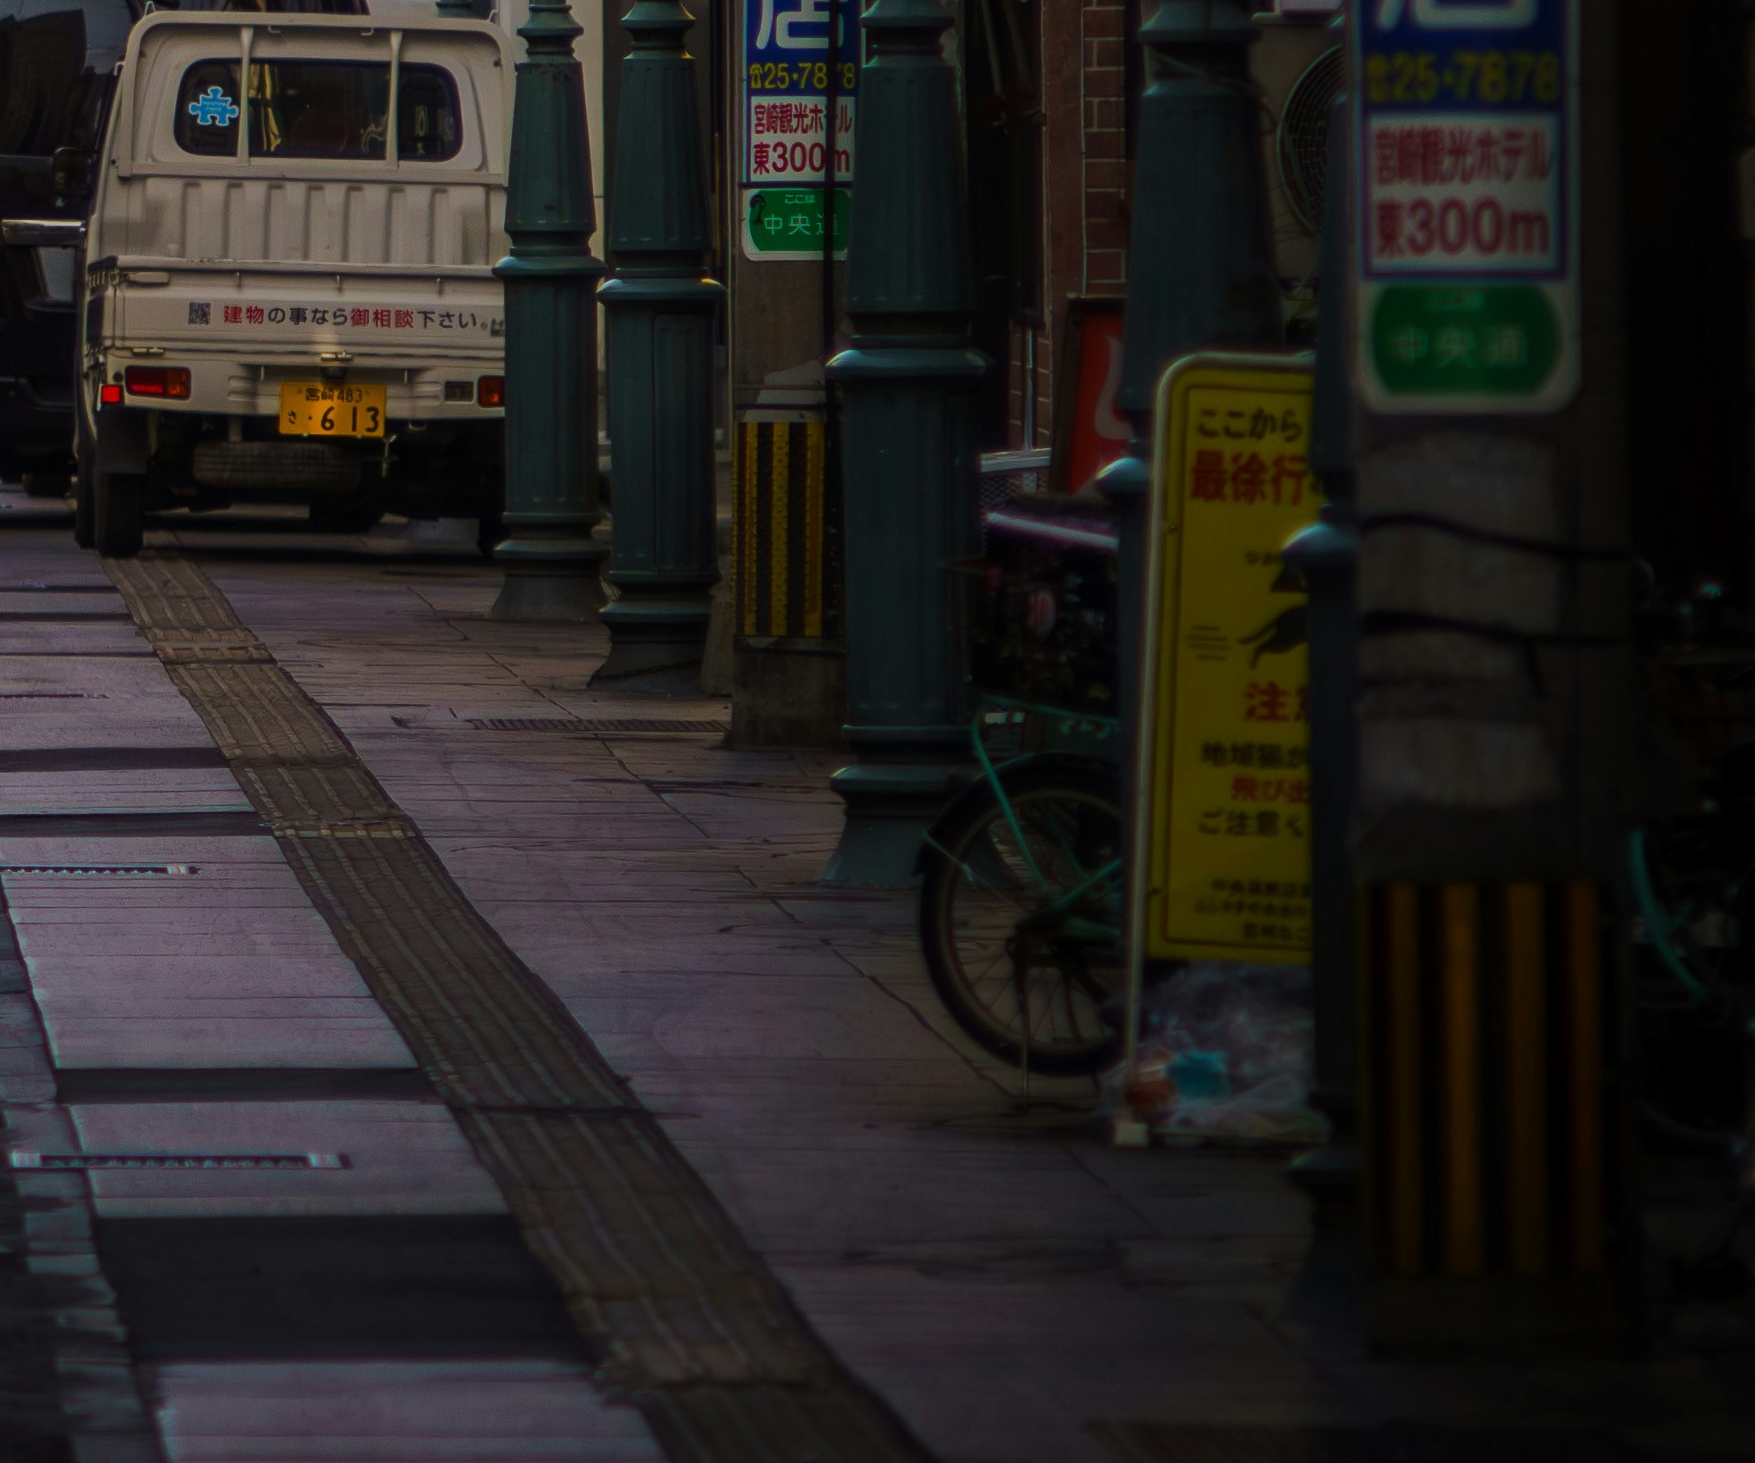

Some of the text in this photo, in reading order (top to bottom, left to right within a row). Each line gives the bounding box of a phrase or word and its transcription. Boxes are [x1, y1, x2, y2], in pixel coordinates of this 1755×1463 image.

[1376, 198, 1551, 257] 東300m
[223, 304, 489, 331] 建物の事なら御相談下さい。
[1197, 407, 1303, 442] ここから
[1191, 450, 1321, 506] 最徐行
